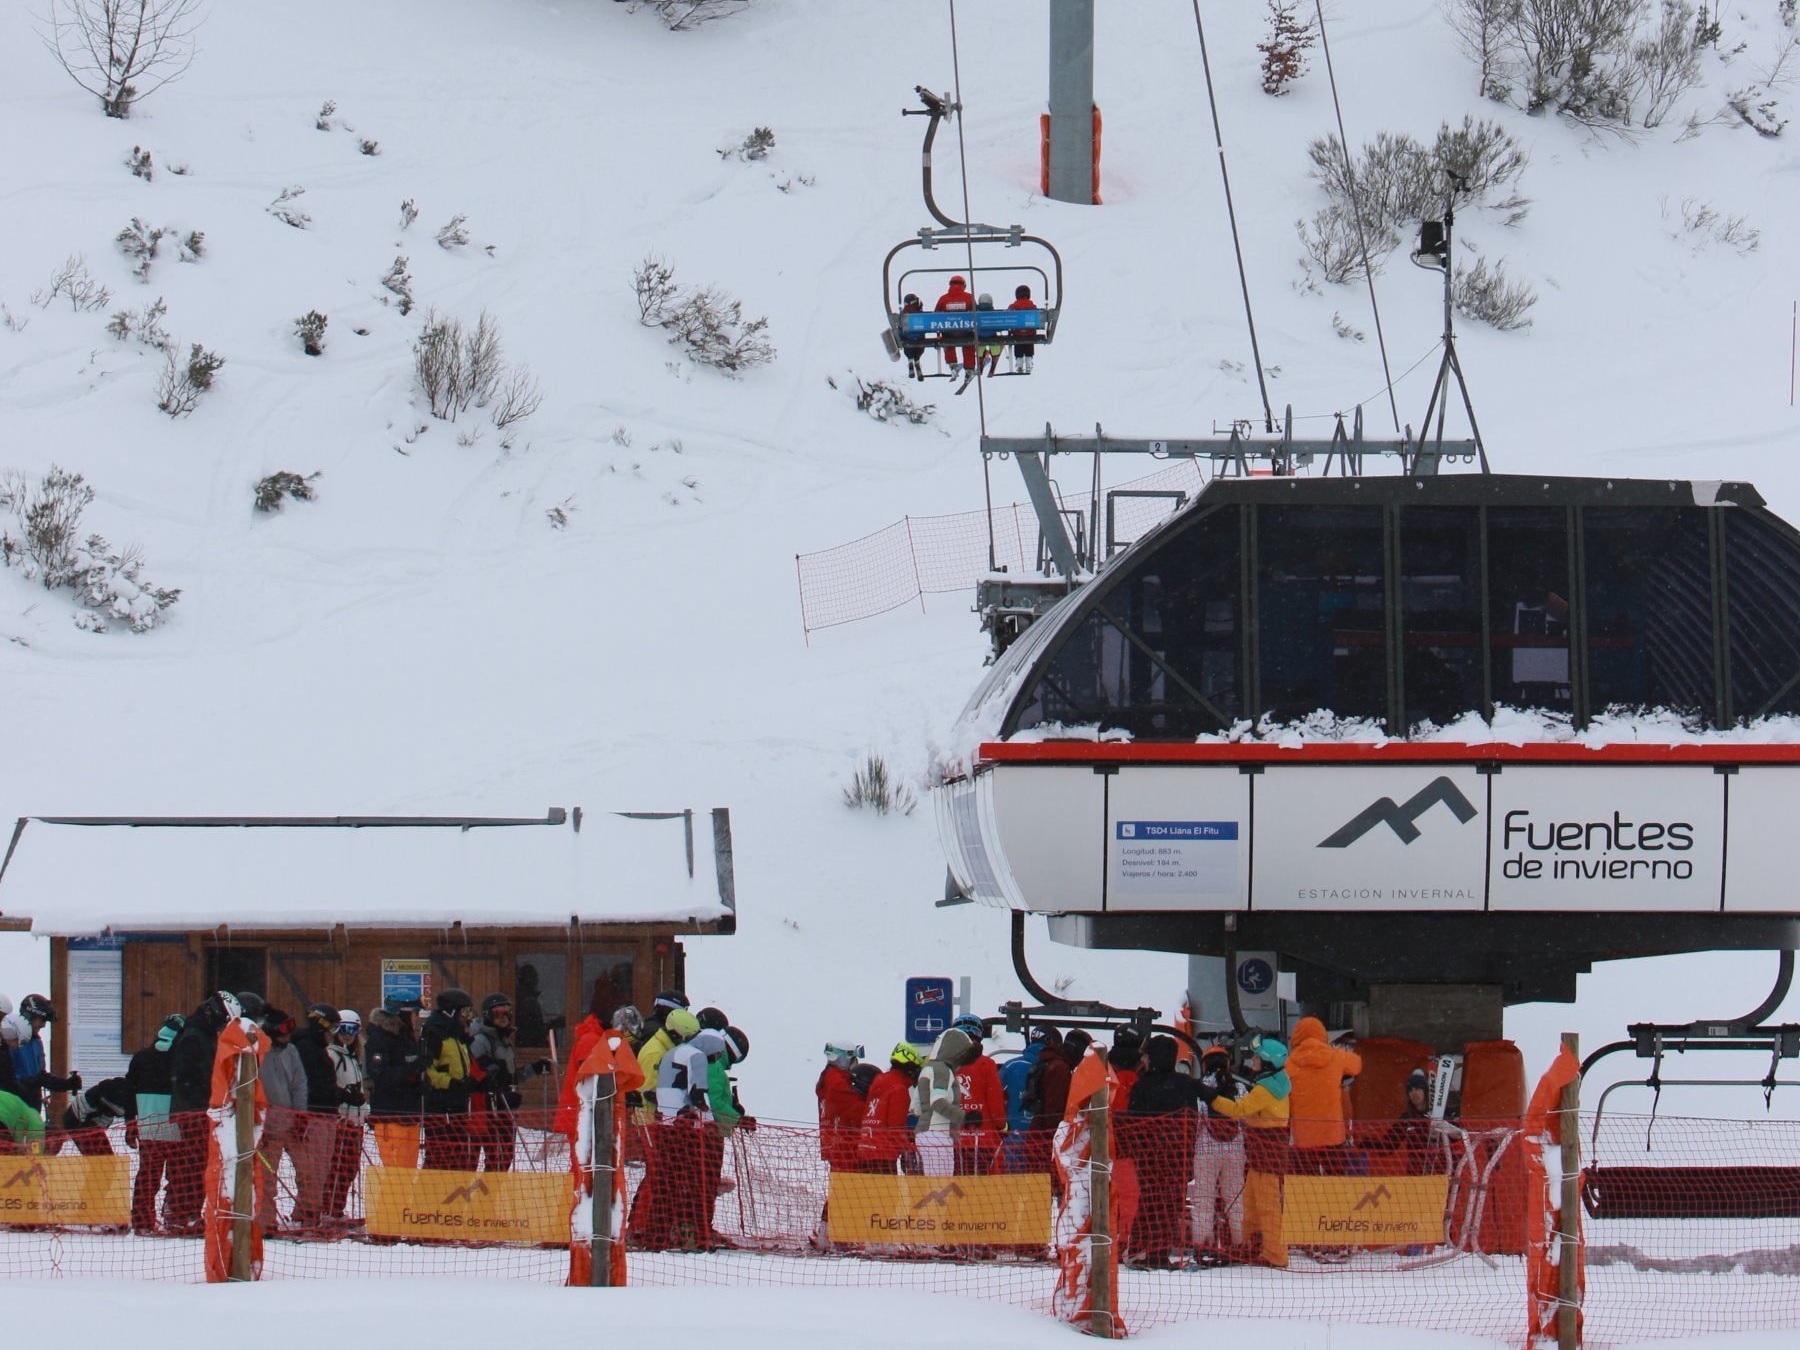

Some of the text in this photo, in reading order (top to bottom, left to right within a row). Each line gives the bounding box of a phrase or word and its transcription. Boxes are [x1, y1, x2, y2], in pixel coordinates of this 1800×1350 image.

[1154, 442, 1161, 452] 2
[1503, 852, 1694, 879] de invierno
[1122, 870, 1151, 879] Viajeros
[1391, 889, 1475, 899] INVERNAL
[1436, 1071, 1447, 1107] SALOMON
[467, 1217, 480, 1227] de
[483, 1218, 529, 1228] invierno
[941, 1219, 955, 1231] de
[958, 1220, 1007, 1231] invierno
[1372, 1221, 1383, 1232] de
